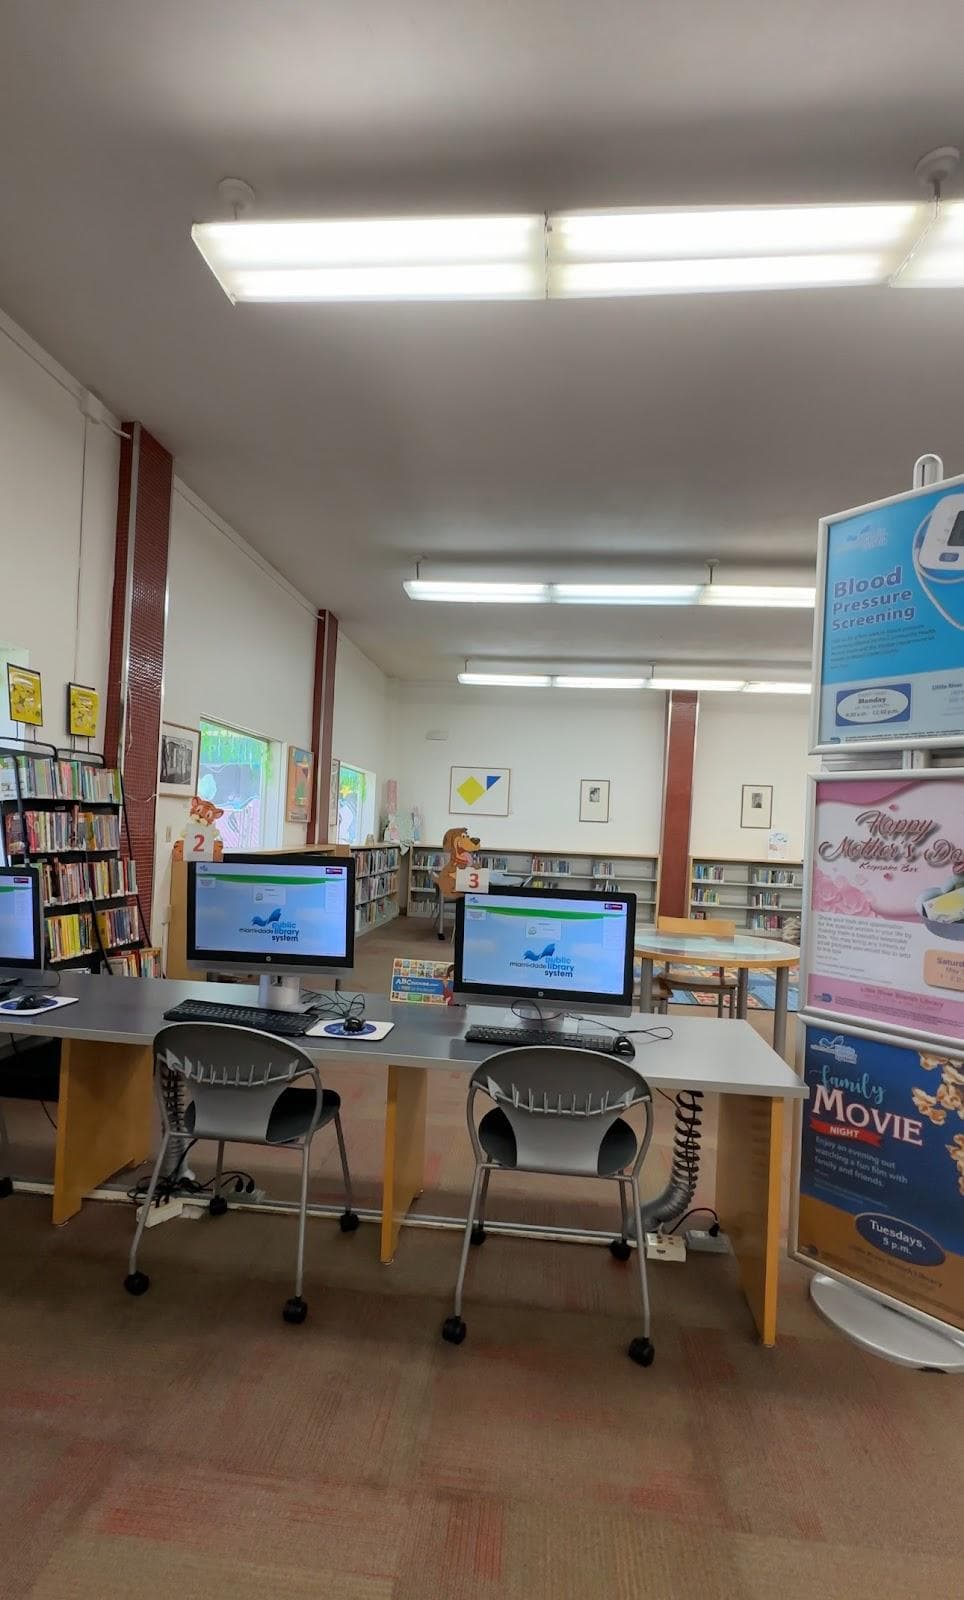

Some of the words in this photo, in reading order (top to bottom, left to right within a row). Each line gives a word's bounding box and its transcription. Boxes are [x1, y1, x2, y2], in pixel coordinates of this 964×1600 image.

[834, 566, 902, 598] Blood
[833, 590, 912, 615] Pressure
[832, 607, 915, 631] Screening
[856, 810, 933, 842] Happy
[193, 834, 205, 852] 2
[819, 836, 914, 860] Mother's
[469, 873, 479, 888] 3
[274, 928, 300, 936] library
[545, 956, 572, 965] public
[547, 963, 574, 972] library
[544, 970, 574, 978] system
[809, 1066, 885, 1104] family
[812, 1084, 923, 1146] MOVIE
[830, 1126, 860, 1138] NIGHT
[816, 1136, 836, 1150] Enjoy
[848, 1148, 880, 1164] evening
[881, 1160, 896, 1169] out
[814, 1156, 837, 1170] family
[838, 1165, 854, 1176] and
[816, 1148, 848, 1165] watching
[856, 1160, 870, 1171] fun
[872, 1166, 888, 1178] film
[889, 1173, 908, 1184] with
[883, 1237, 888, 1245] 5
